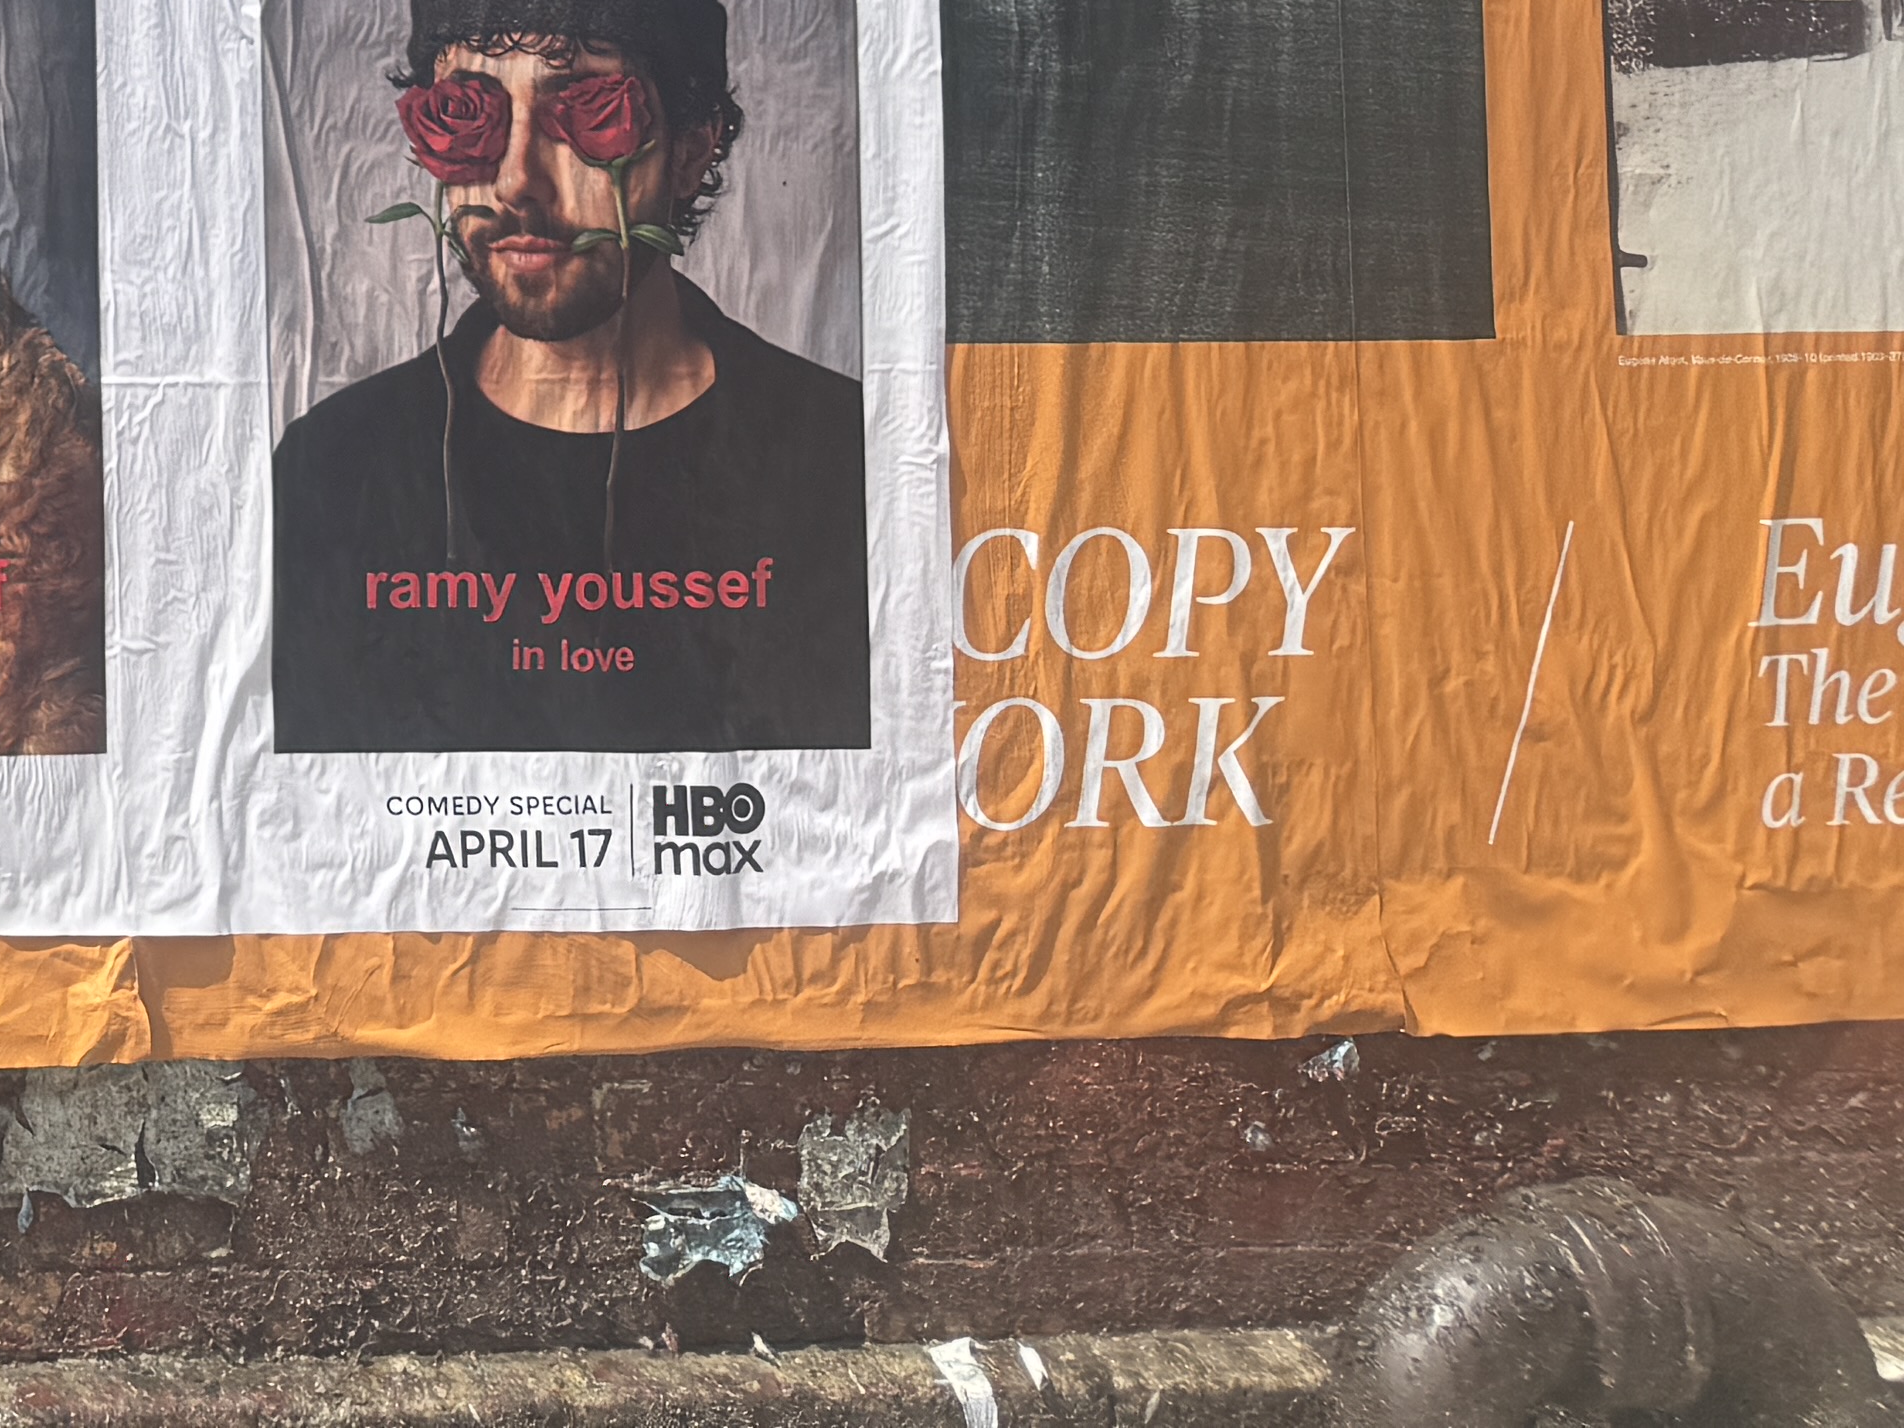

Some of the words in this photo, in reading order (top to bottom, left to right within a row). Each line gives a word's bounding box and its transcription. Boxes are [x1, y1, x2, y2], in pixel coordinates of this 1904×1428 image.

[366, 571, 516, 622] ramy
[539, 557, 774, 624] youssef
[952, 527, 1355, 660] COPY
[1748, 518, 1904, 646] Eu
[512, 639, 544, 670] in
[561, 639, 635, 672] love
[1759, 648, 1897, 726] The
[952, 696, 1285, 831] ORK
[387, 796, 499, 815] COMEDY
[510, 796, 612, 815] SPECIAL
[653, 782, 766, 837] HBO
[1761, 772, 1805, 828] a
[426, 830, 558, 868] APRIL
[570, 829, 612, 868] 17
[654, 839, 764, 876] max
